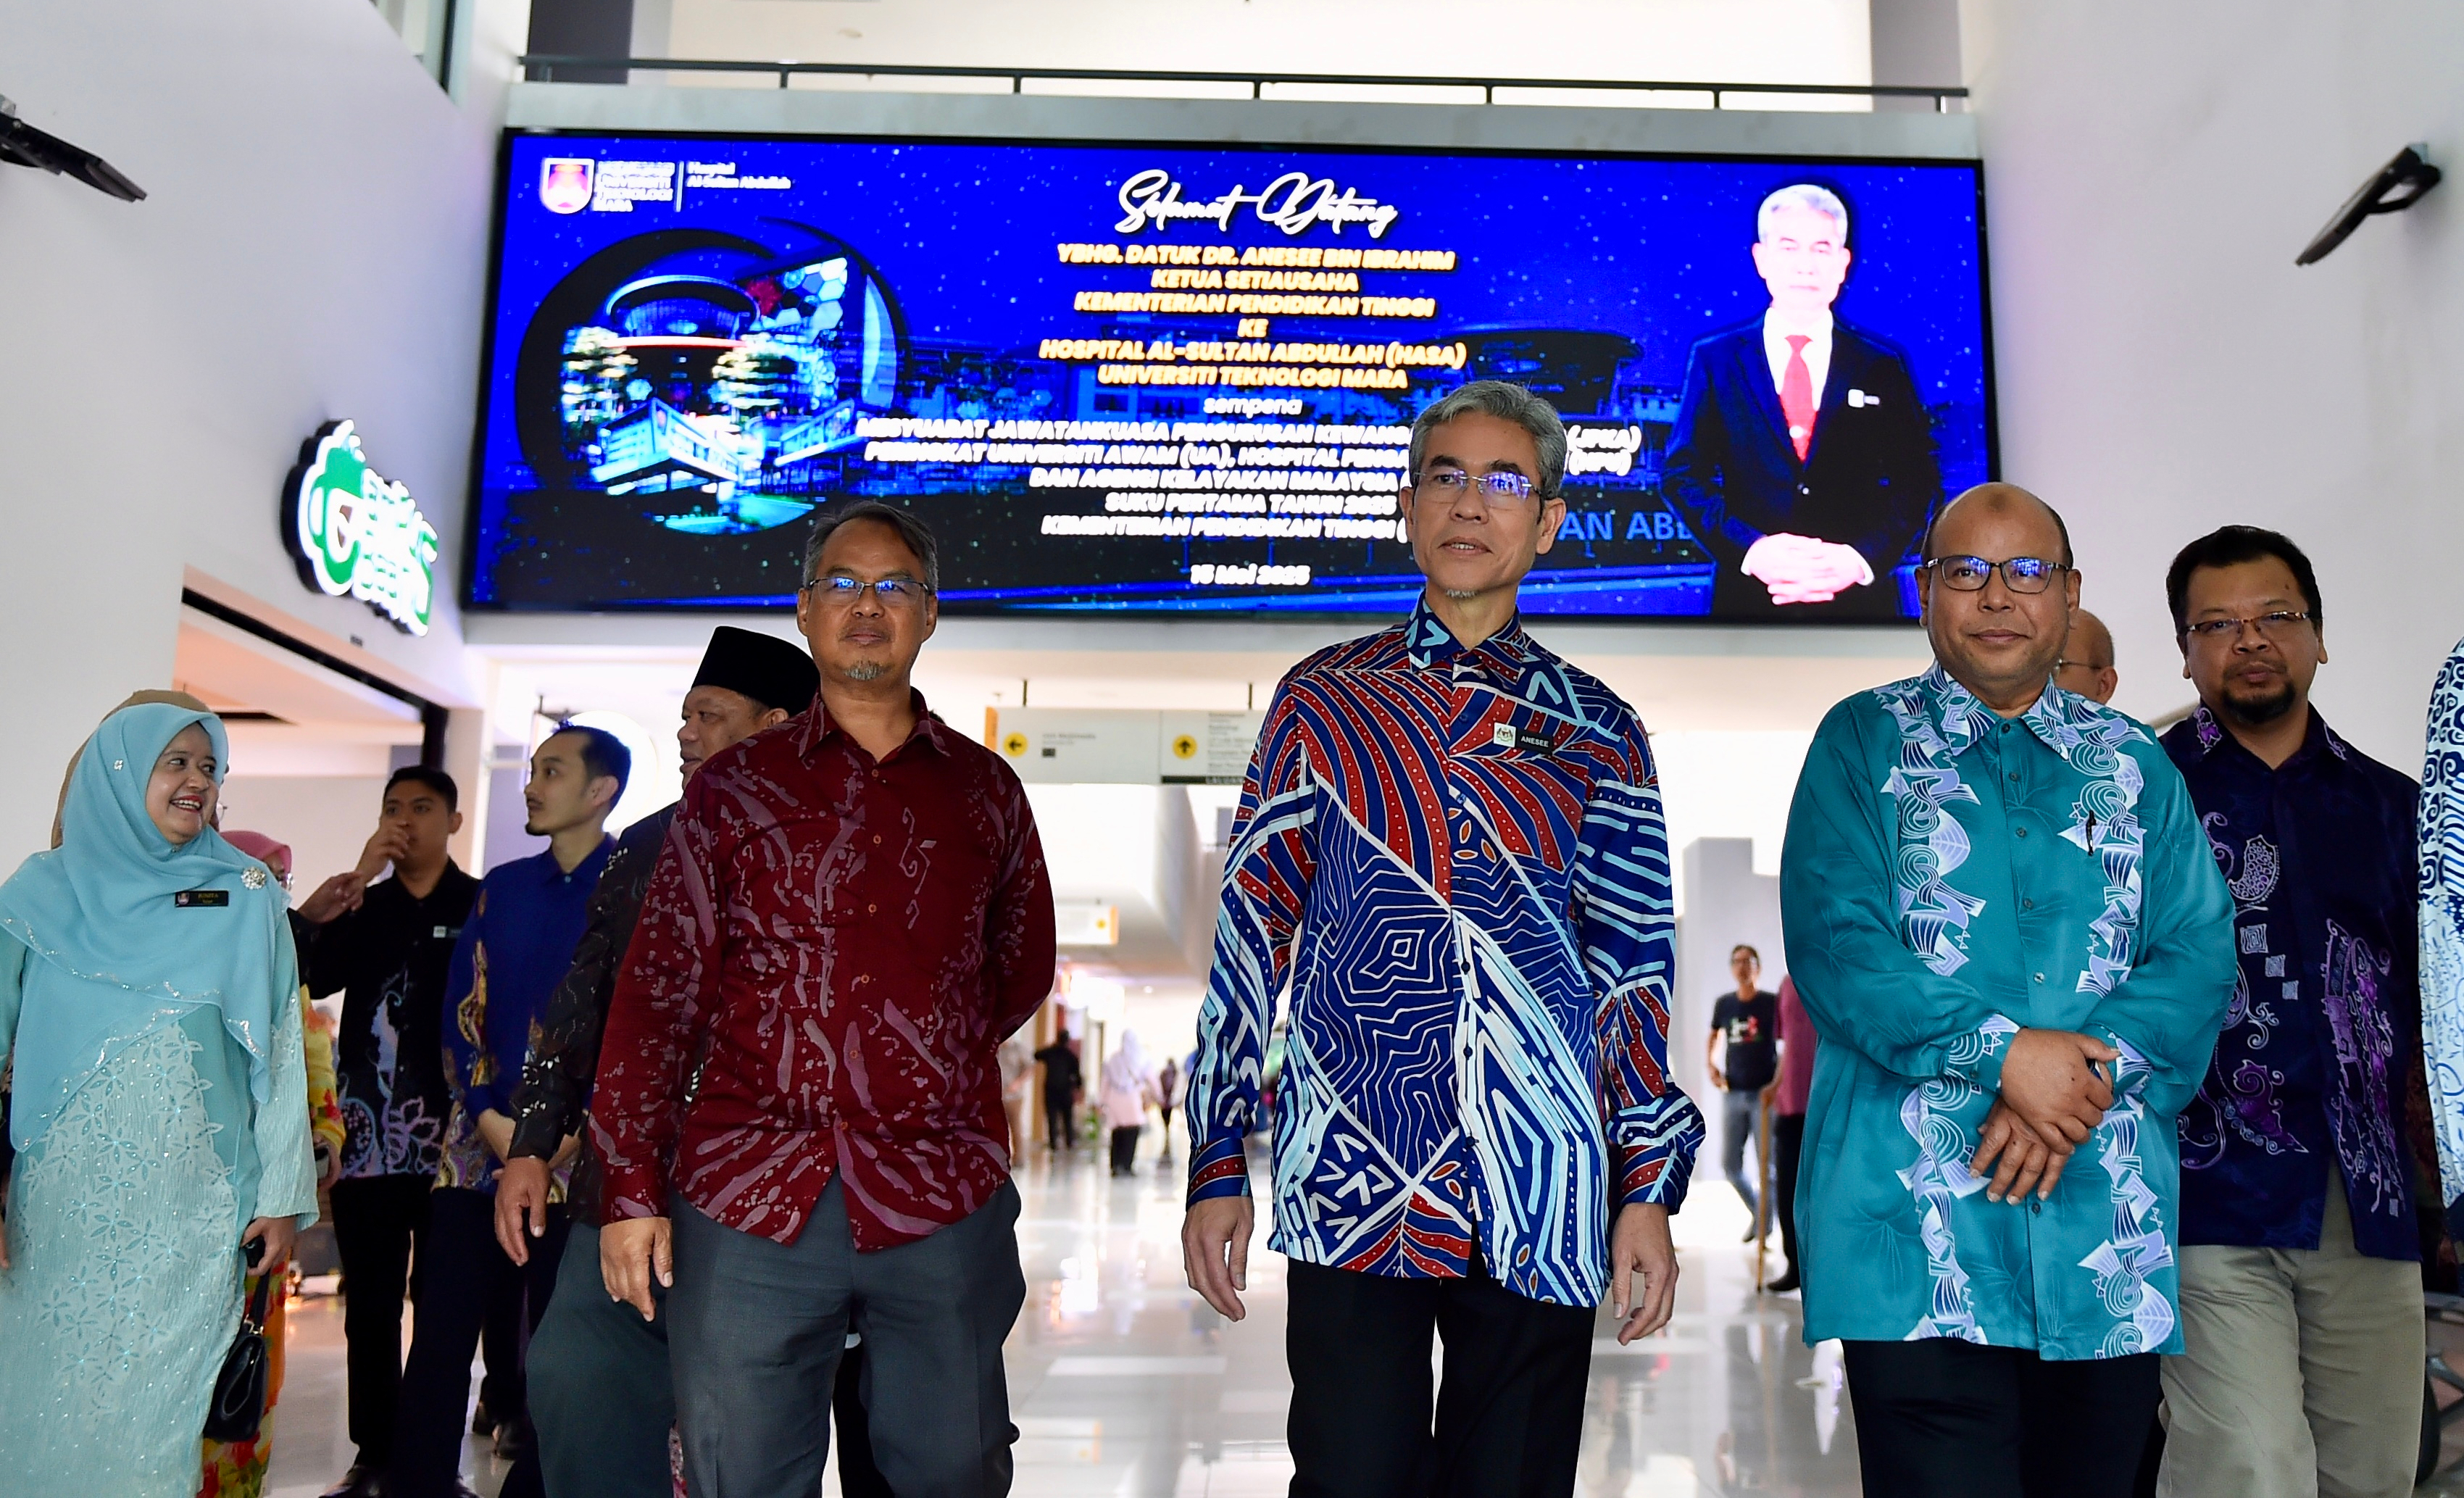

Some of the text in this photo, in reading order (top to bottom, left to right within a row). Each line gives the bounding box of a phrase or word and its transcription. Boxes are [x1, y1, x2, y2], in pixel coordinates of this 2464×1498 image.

[1115, 170, 1397, 238] Selamat Datang
[1057, 244, 1455, 270] YBHG. DATUK DR. ANESEE BIN IBRAHIM
[1151, 270, 1358, 291] KETUA SETIAUSAHA
[1074, 292, 1435, 317] KEMENTERIAN PENDIDIKAN TINGGI
[1238, 319, 1268, 337] KE
[1039, 339, 1467, 370] HOSPITAL AL-SULTAN ABDULLAH (HASA)
[1098, 365, 1407, 388] UNIVERSITI TEKNOLOGI MARA
[1204, 398, 1302, 418] sempena
[856, 418, 989, 438] MESYUARAT
[988, 420, 1170, 441] JAWATANKUASA
[1171, 423, 1314, 443] PENGURUSAN
[865, 441, 988, 462] PERINGKAT
[987, 444, 1104, 464] UNIVERSITI
[1104, 445, 1179, 465] AWAM
[1180, 443, 1236, 469] (UA),
[1238, 447, 1339, 467] HOSPITAL
[1029, 467, 1080, 487] DAN
[1079, 469, 1160, 488] AGENSI
[1160, 470, 1289, 490] KELAYAKAN
[1289, 471, 1398, 491] MALAYSIA
[1105, 492, 1397, 515] SUKU PERTAMA TAHUN 2025
[1041, 515, 1191, 536] KEMENTERIAN
[1191, 517, 1322, 537] PENDIDIKAN
[1323, 519, 1397, 538] TINGGI
[1257, 565, 1310, 585] 2025
[1520, 736, 1549, 747] ANESEE
